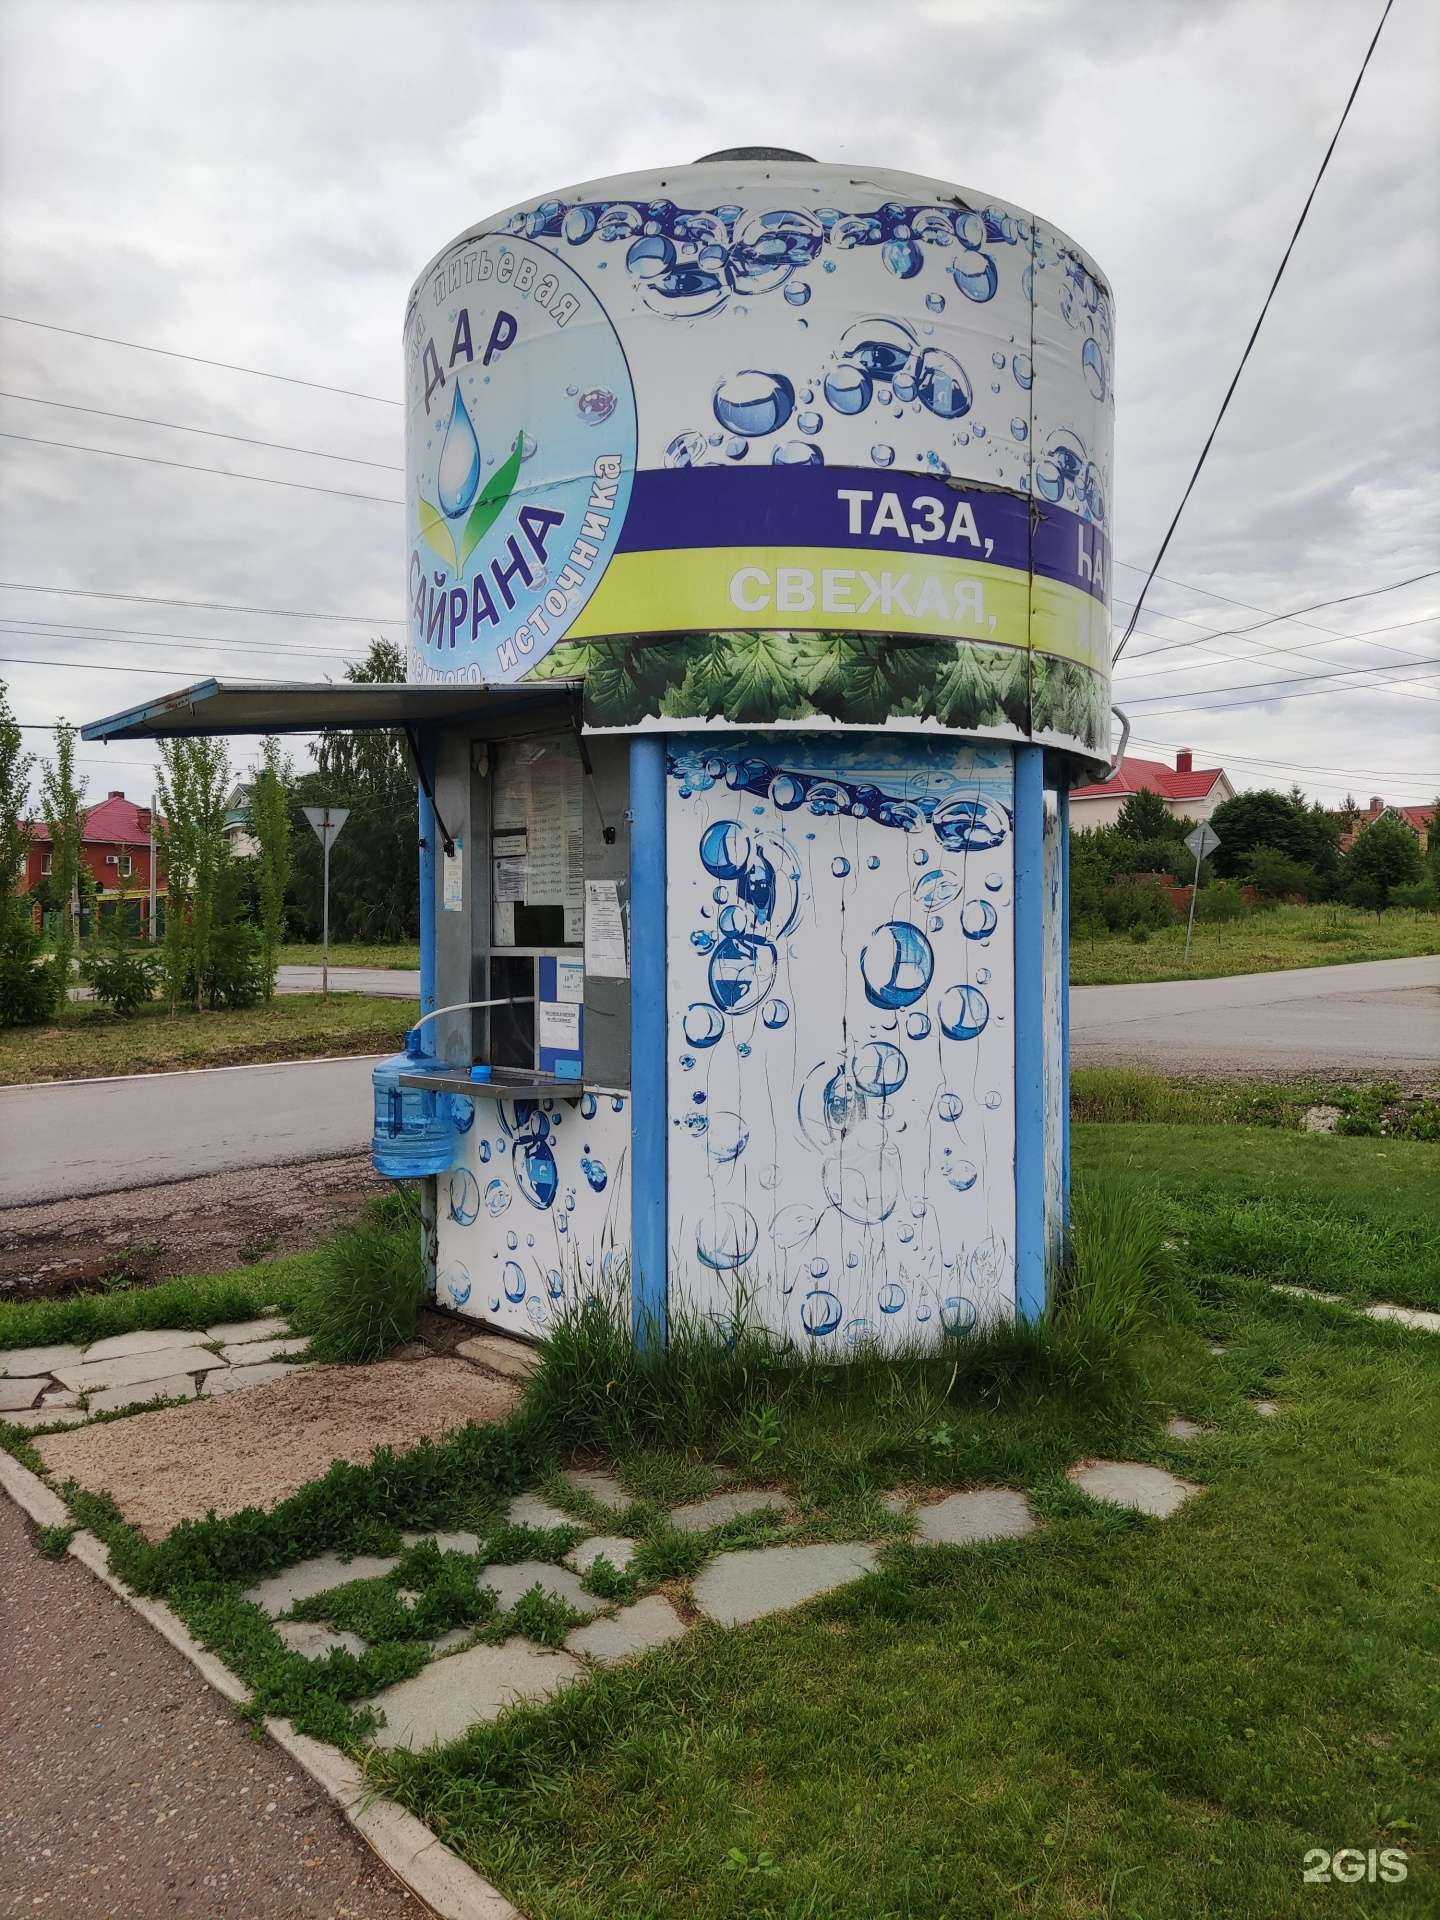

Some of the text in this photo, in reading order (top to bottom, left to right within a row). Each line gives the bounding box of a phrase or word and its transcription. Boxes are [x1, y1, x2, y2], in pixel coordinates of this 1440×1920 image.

[434, 250, 580, 328] питьевая
[423, 309, 518, 415] ДАР
[410, 505, 565, 650] САЙРАНА
[496, 455, 623, 672] источника
[729, 567, 997, 634] СВЕЖАЯ,
